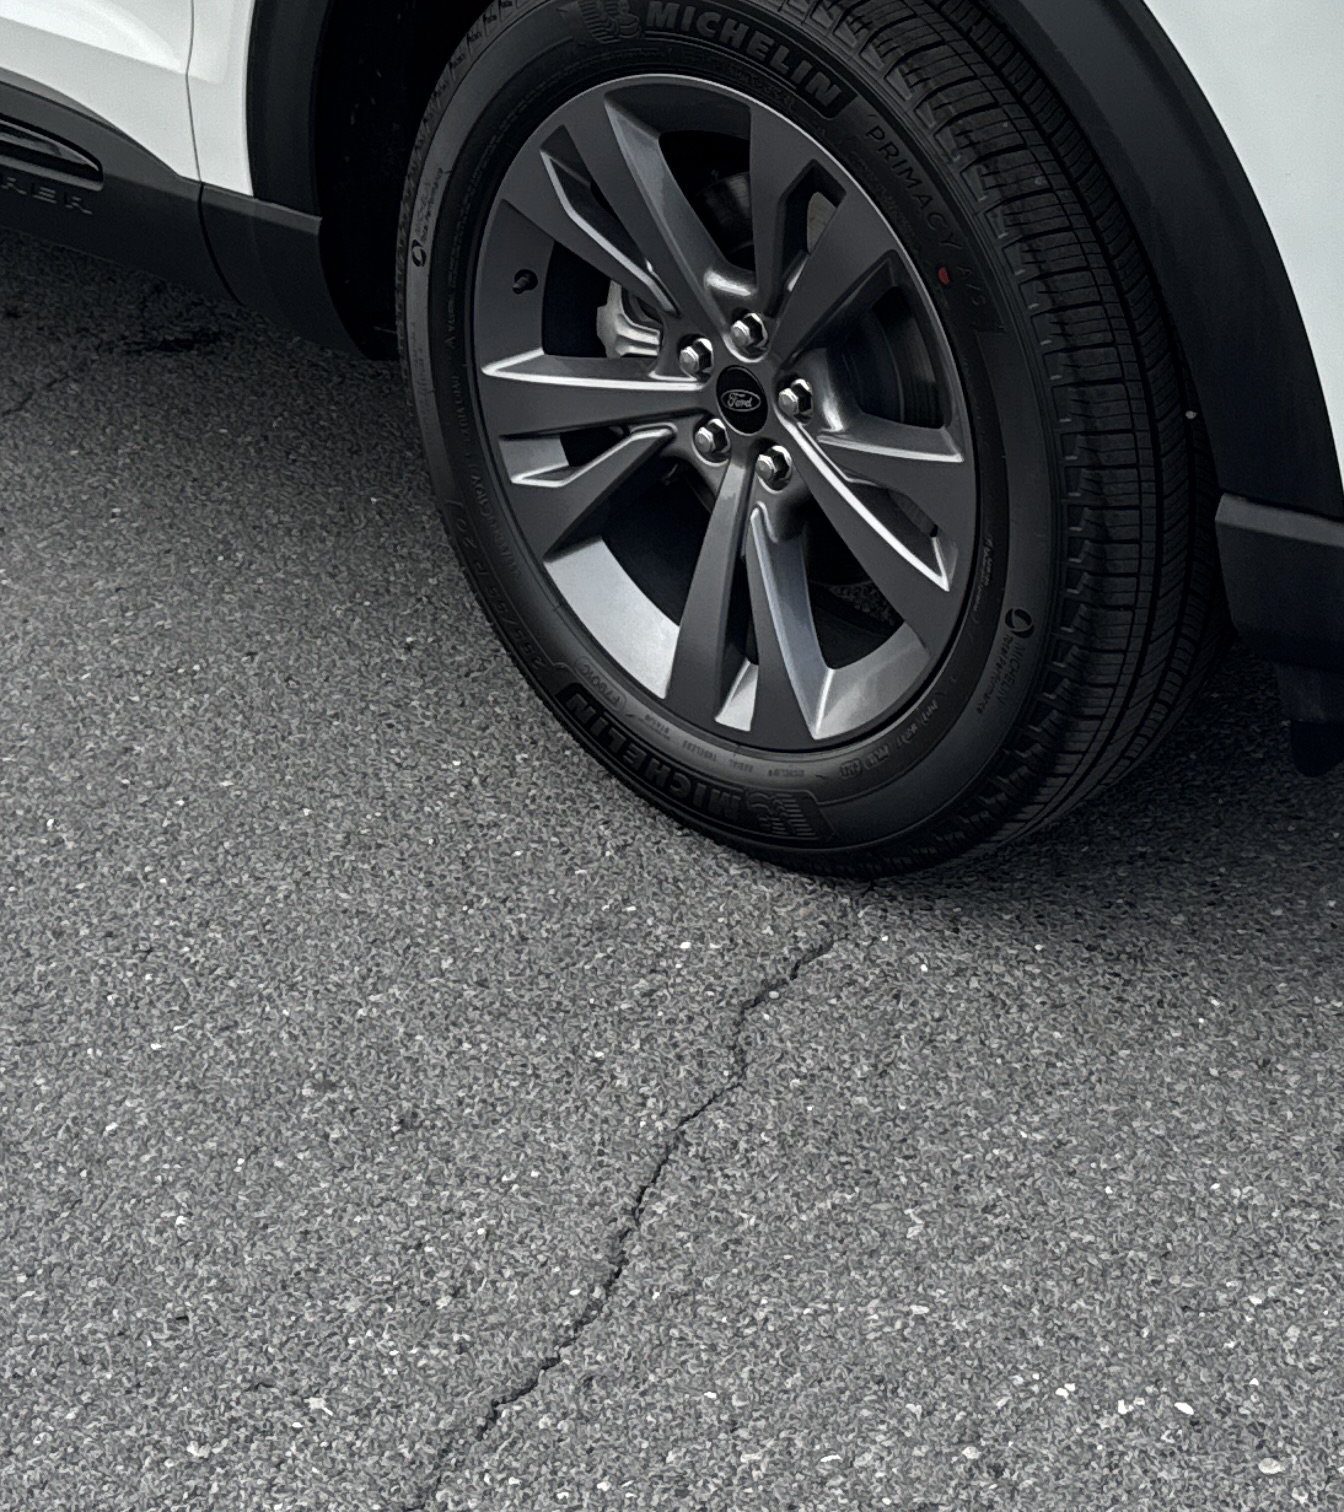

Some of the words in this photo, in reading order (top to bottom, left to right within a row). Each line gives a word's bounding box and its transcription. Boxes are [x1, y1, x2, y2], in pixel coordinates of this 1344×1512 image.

[645, 0, 843, 108] MICHELIN
[865, 124, 963, 251] PRIMACY
[955, 264, 987, 307] A/S
[726, 391, 753, 409] Ford
[566, 692, 744, 819] MICHELIN
